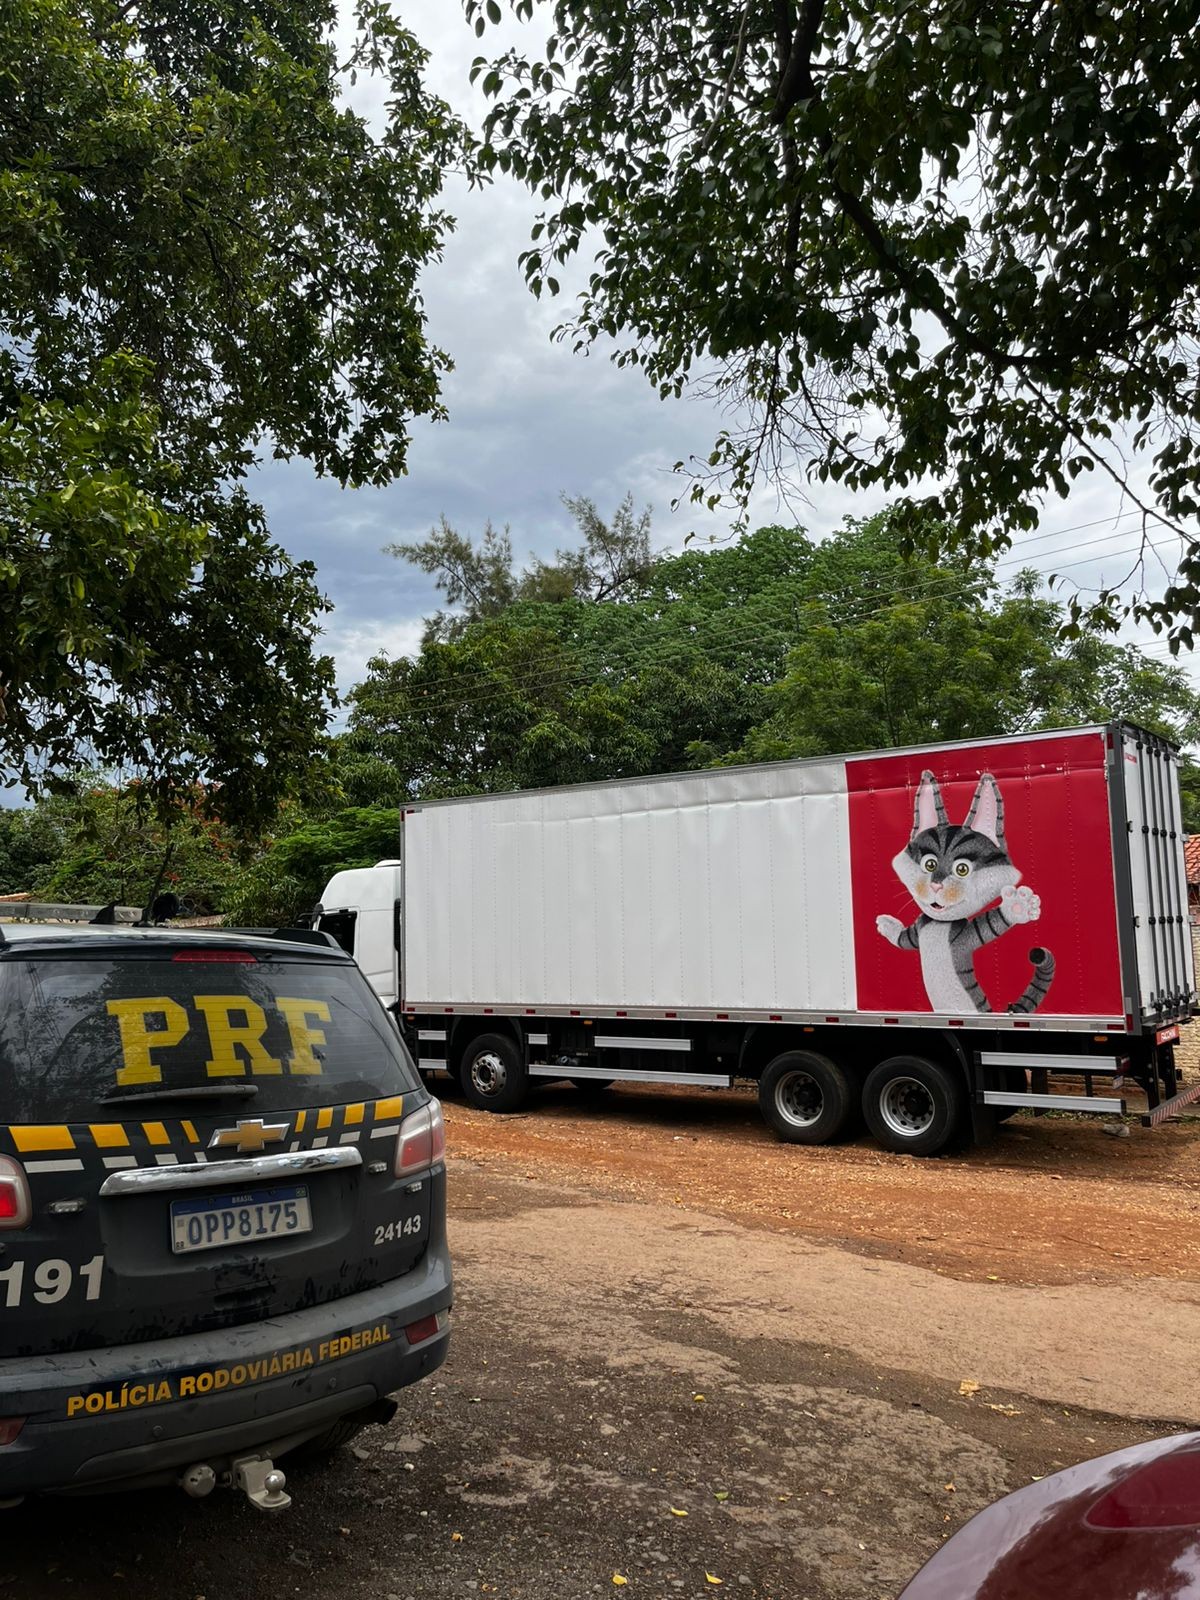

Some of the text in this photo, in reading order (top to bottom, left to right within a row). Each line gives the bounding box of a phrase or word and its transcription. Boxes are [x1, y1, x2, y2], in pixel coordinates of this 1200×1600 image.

[106, 995, 332, 1086] PRF
[231, 1194, 254, 1204] BRASIL
[188, 1202, 298, 1245] OPP8I75
[374, 1214, 421, 1245] 24143
[0, 1255, 104, 1307] 191
[67, 1324, 391, 1416] POLÍCIA RODOVIÁRIA FEDERAL
